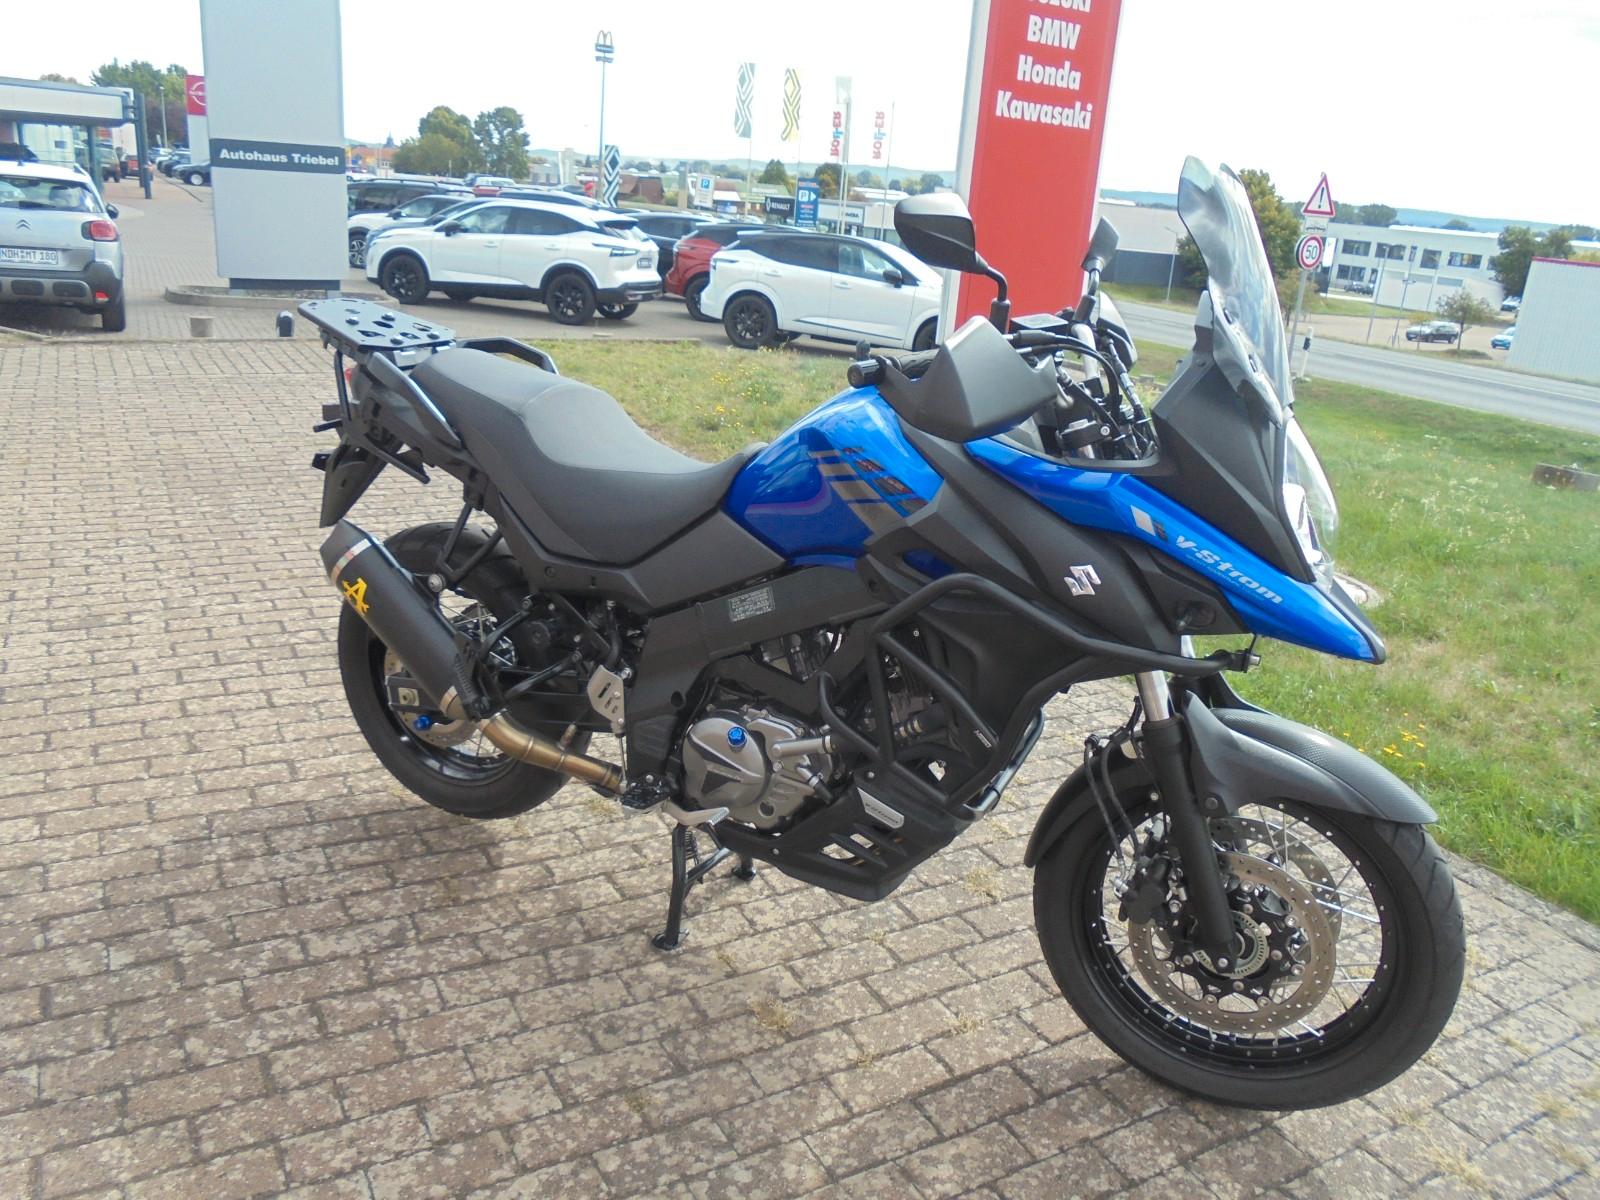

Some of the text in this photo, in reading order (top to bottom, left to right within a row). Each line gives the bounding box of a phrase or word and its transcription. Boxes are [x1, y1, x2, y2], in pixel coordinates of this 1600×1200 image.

[1027, 14, 1081, 50] BMW
[1017, 54, 1081, 90] Honda
[995, 90, 1093, 130] Kawasaki
[220, 148, 340, 166] Autohaus Triebel
[1305, 244, 1318, 260] 50
